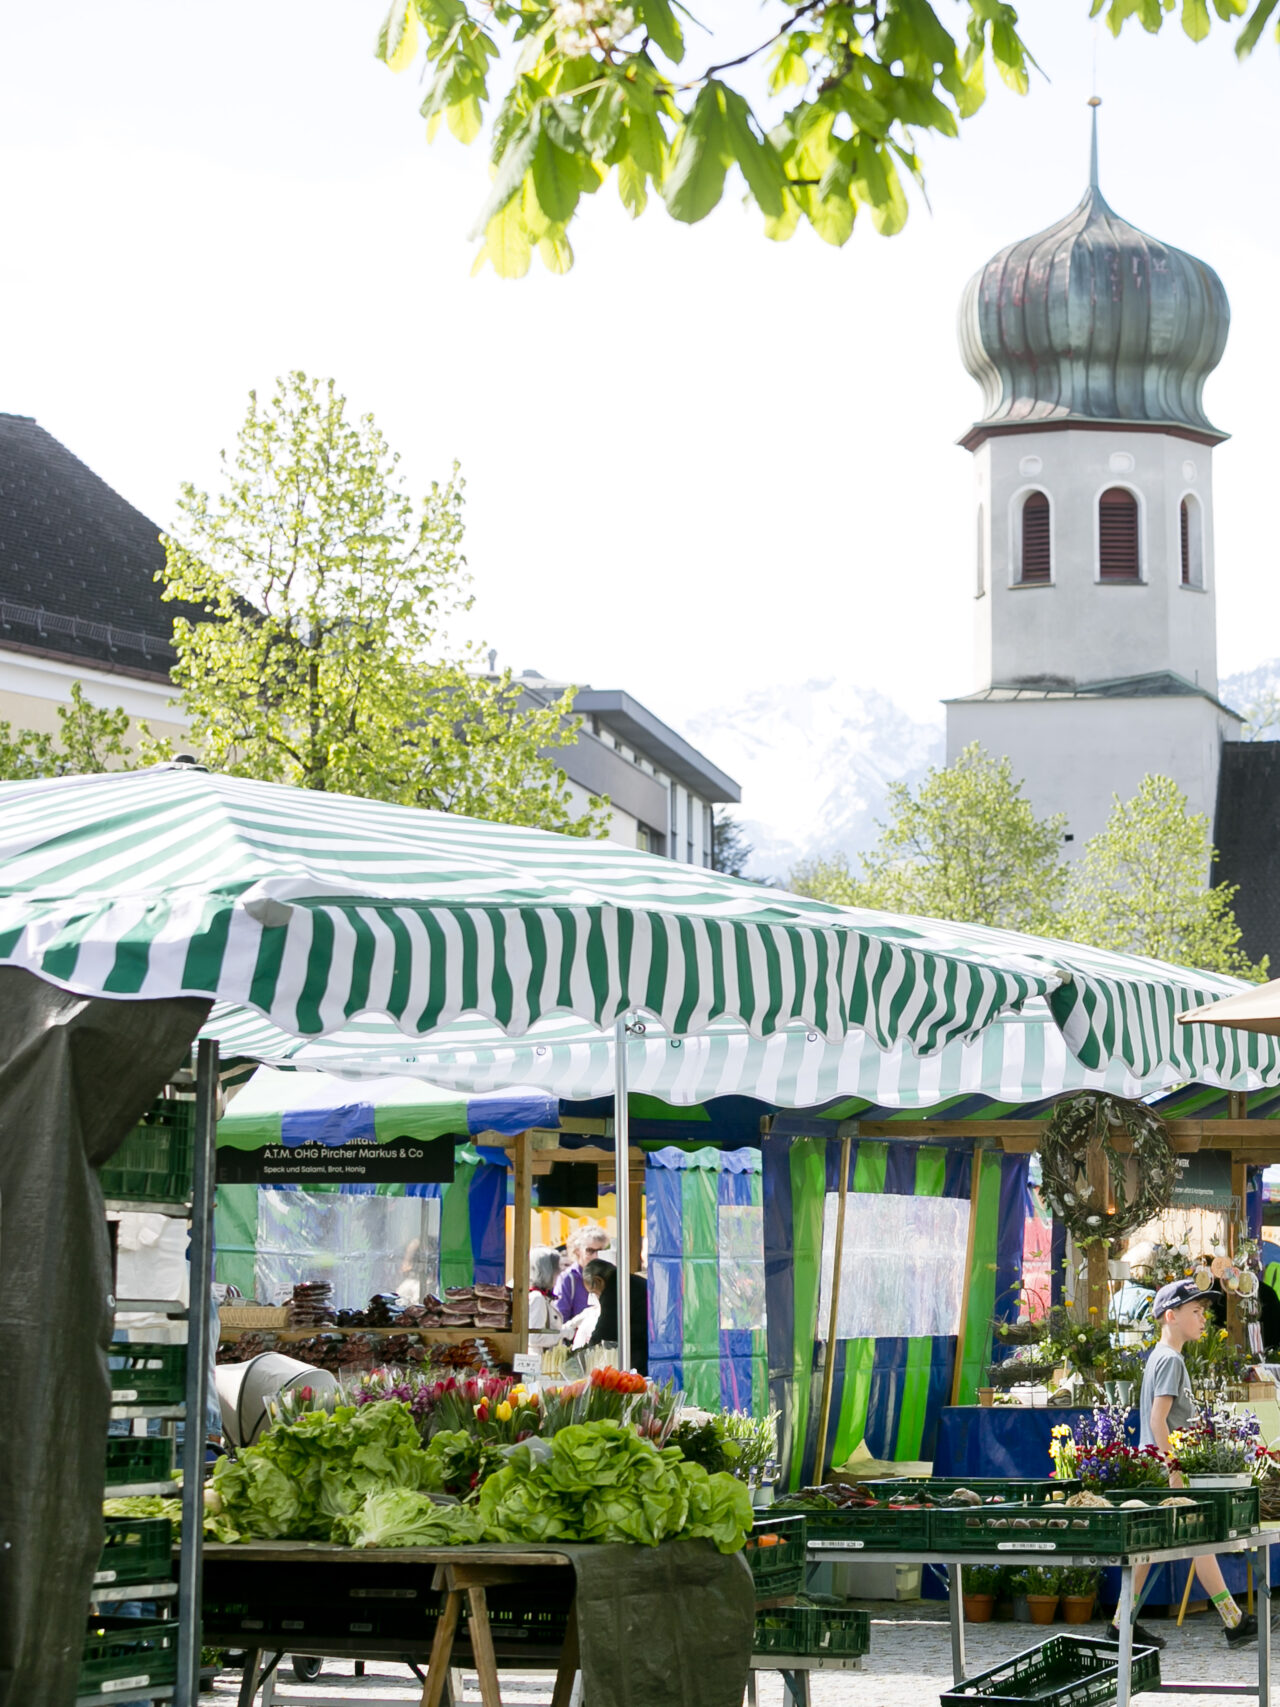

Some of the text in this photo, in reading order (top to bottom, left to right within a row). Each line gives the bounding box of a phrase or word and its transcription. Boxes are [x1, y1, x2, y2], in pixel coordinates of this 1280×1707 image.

[264, 1148, 424, 1158] A.T.M. OHG Pircher Markus & Co
[263, 1165, 285, 1174] Speck
[286, 1165, 300, 1173] und
[301, 1165, 327, 1174] Salami,
[328, 1166, 343, 1174] Brot,
[345, 1166, 366, 1175] Honig
